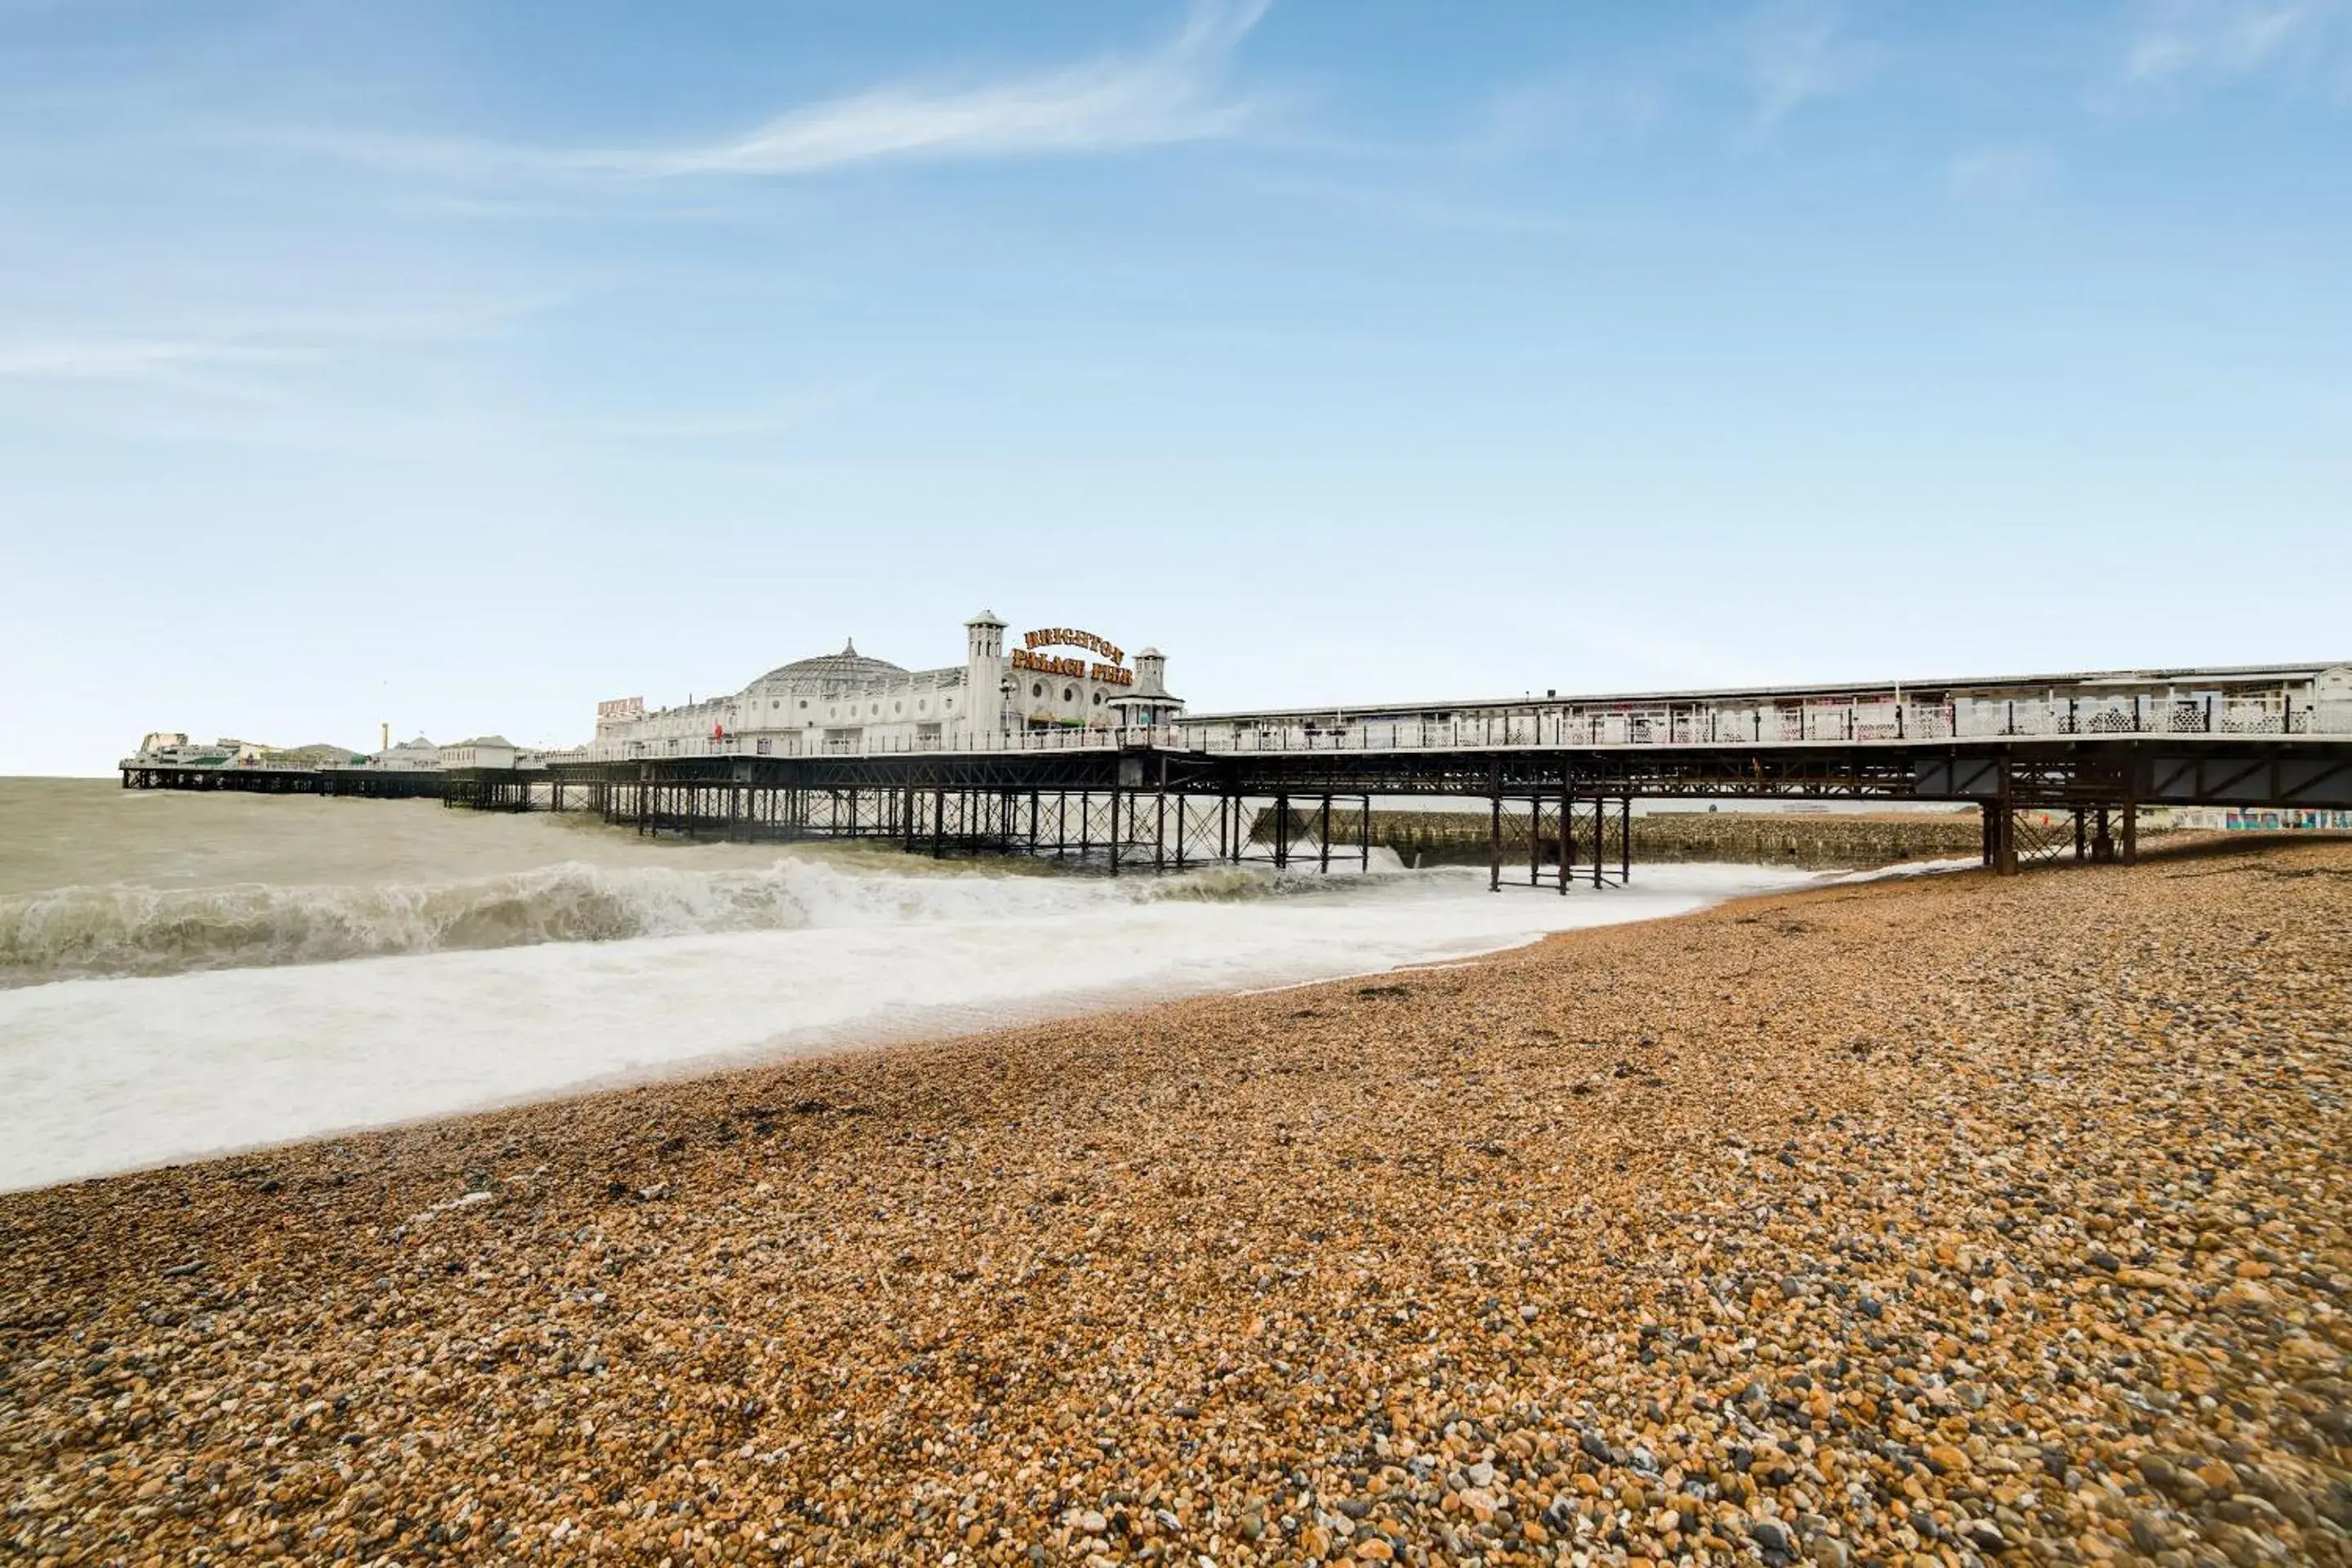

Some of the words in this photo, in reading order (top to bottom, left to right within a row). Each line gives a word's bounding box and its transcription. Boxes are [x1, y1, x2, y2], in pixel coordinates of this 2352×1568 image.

[1024, 627, 1125, 666] BRIGHTON
[1012, 648, 1085, 678] PALACE
[1091, 662, 1134, 685] PIER
